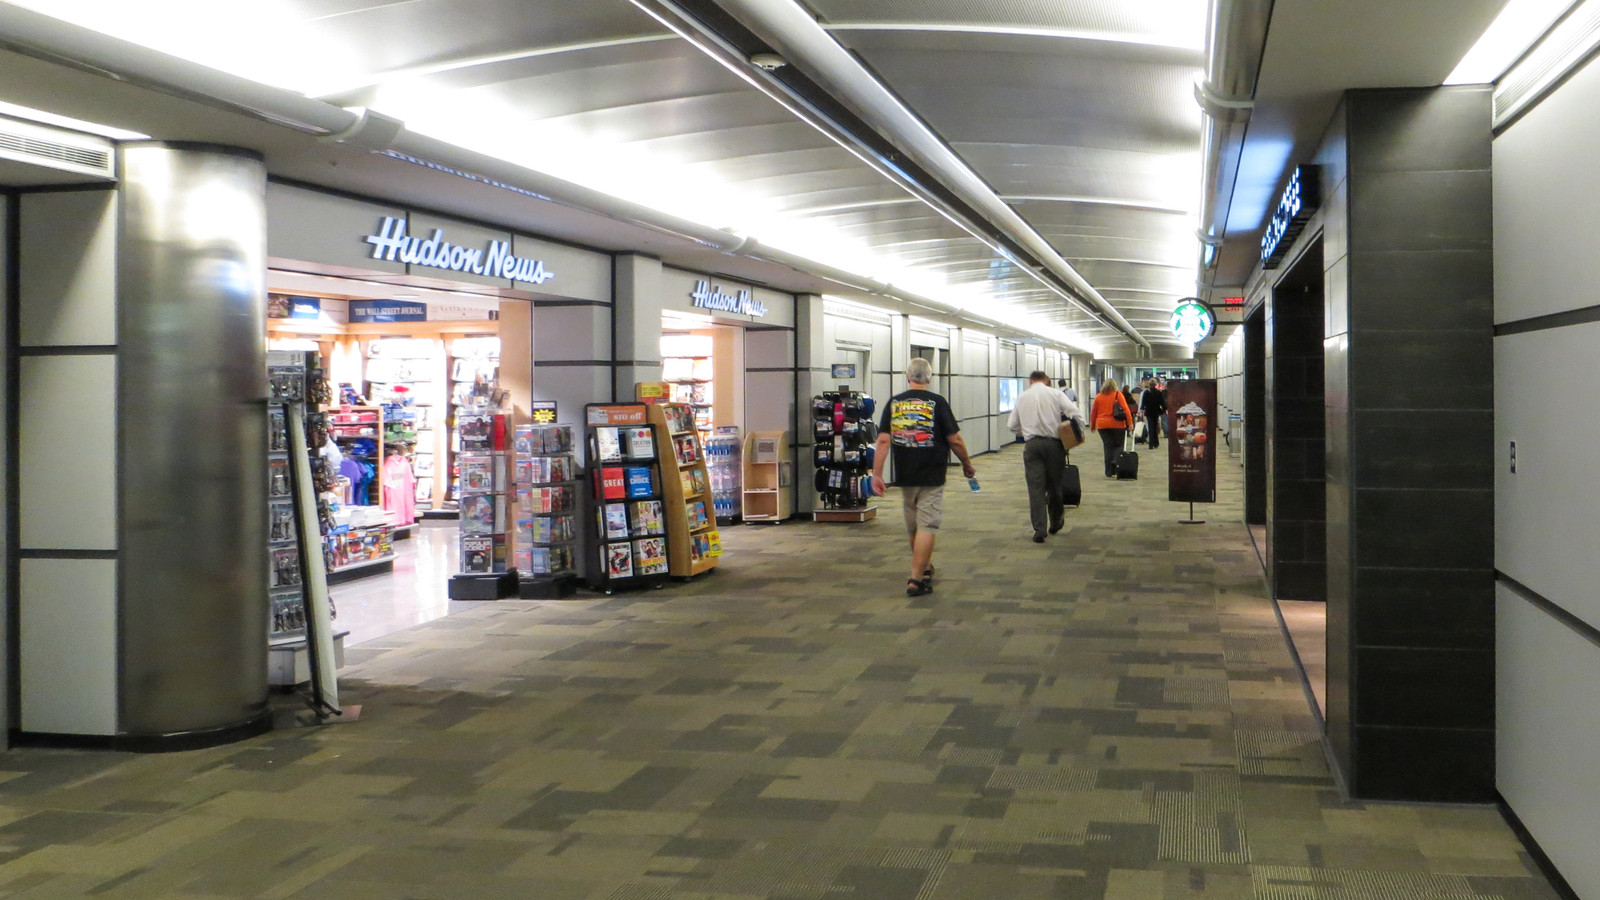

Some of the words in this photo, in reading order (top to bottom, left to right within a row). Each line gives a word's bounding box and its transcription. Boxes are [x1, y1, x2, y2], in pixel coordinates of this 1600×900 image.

[368, 217, 484, 274] Hudson
[483, 239, 554, 285] News
[693, 280, 738, 313] Hudson
[738, 289, 769, 318] News
[355, 308, 366, 316] THE
[366, 307, 380, 316] WALL
[381, 307, 401, 315] STREET
[401, 306, 424, 315] JOURNAL
[629, 412, 642, 420] off
[603, 478, 625, 488] GREAT
